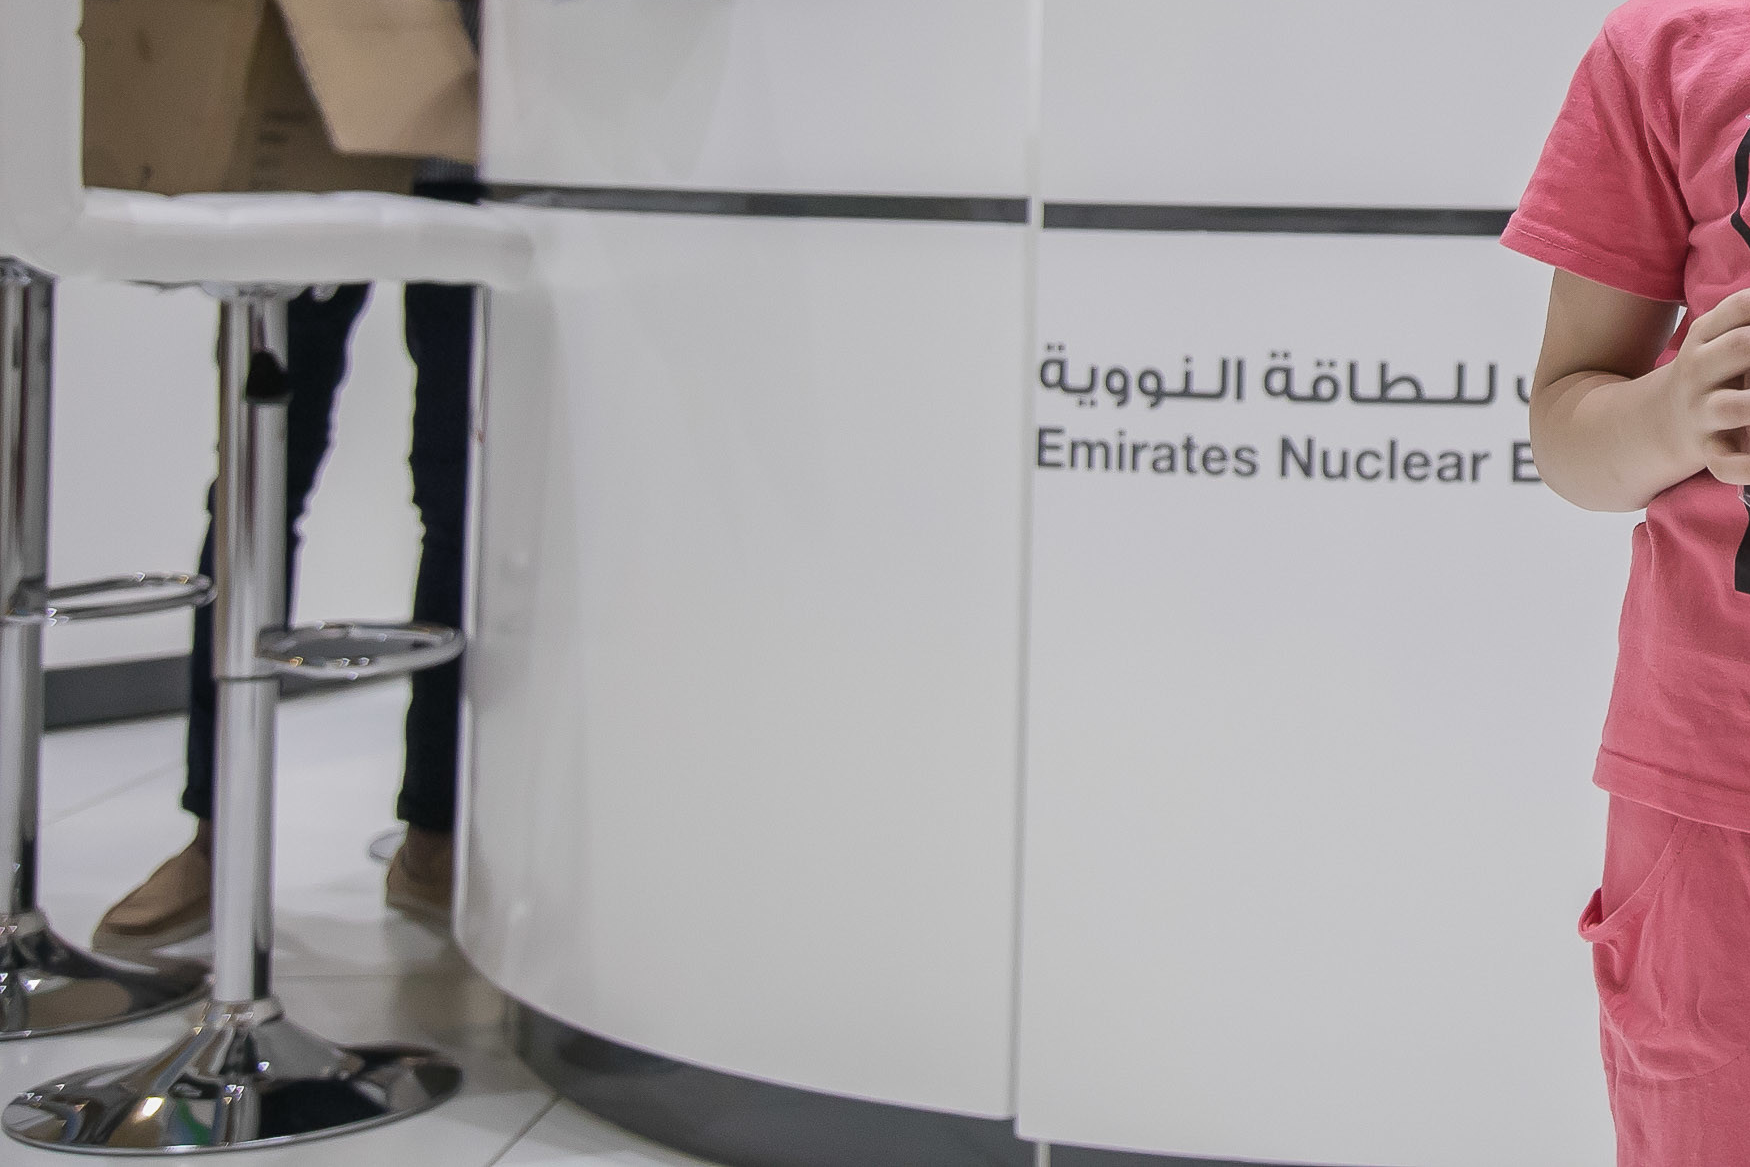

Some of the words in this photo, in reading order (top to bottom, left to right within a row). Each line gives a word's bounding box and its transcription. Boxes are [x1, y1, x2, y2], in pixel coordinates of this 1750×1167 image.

[1038, 343, 1246, 409] النووية
[1262, 350, 1498, 407] للطاقة
[1036, 427, 1259, 479] Emirates
[1279, 435, 1491, 484] Nuclear
